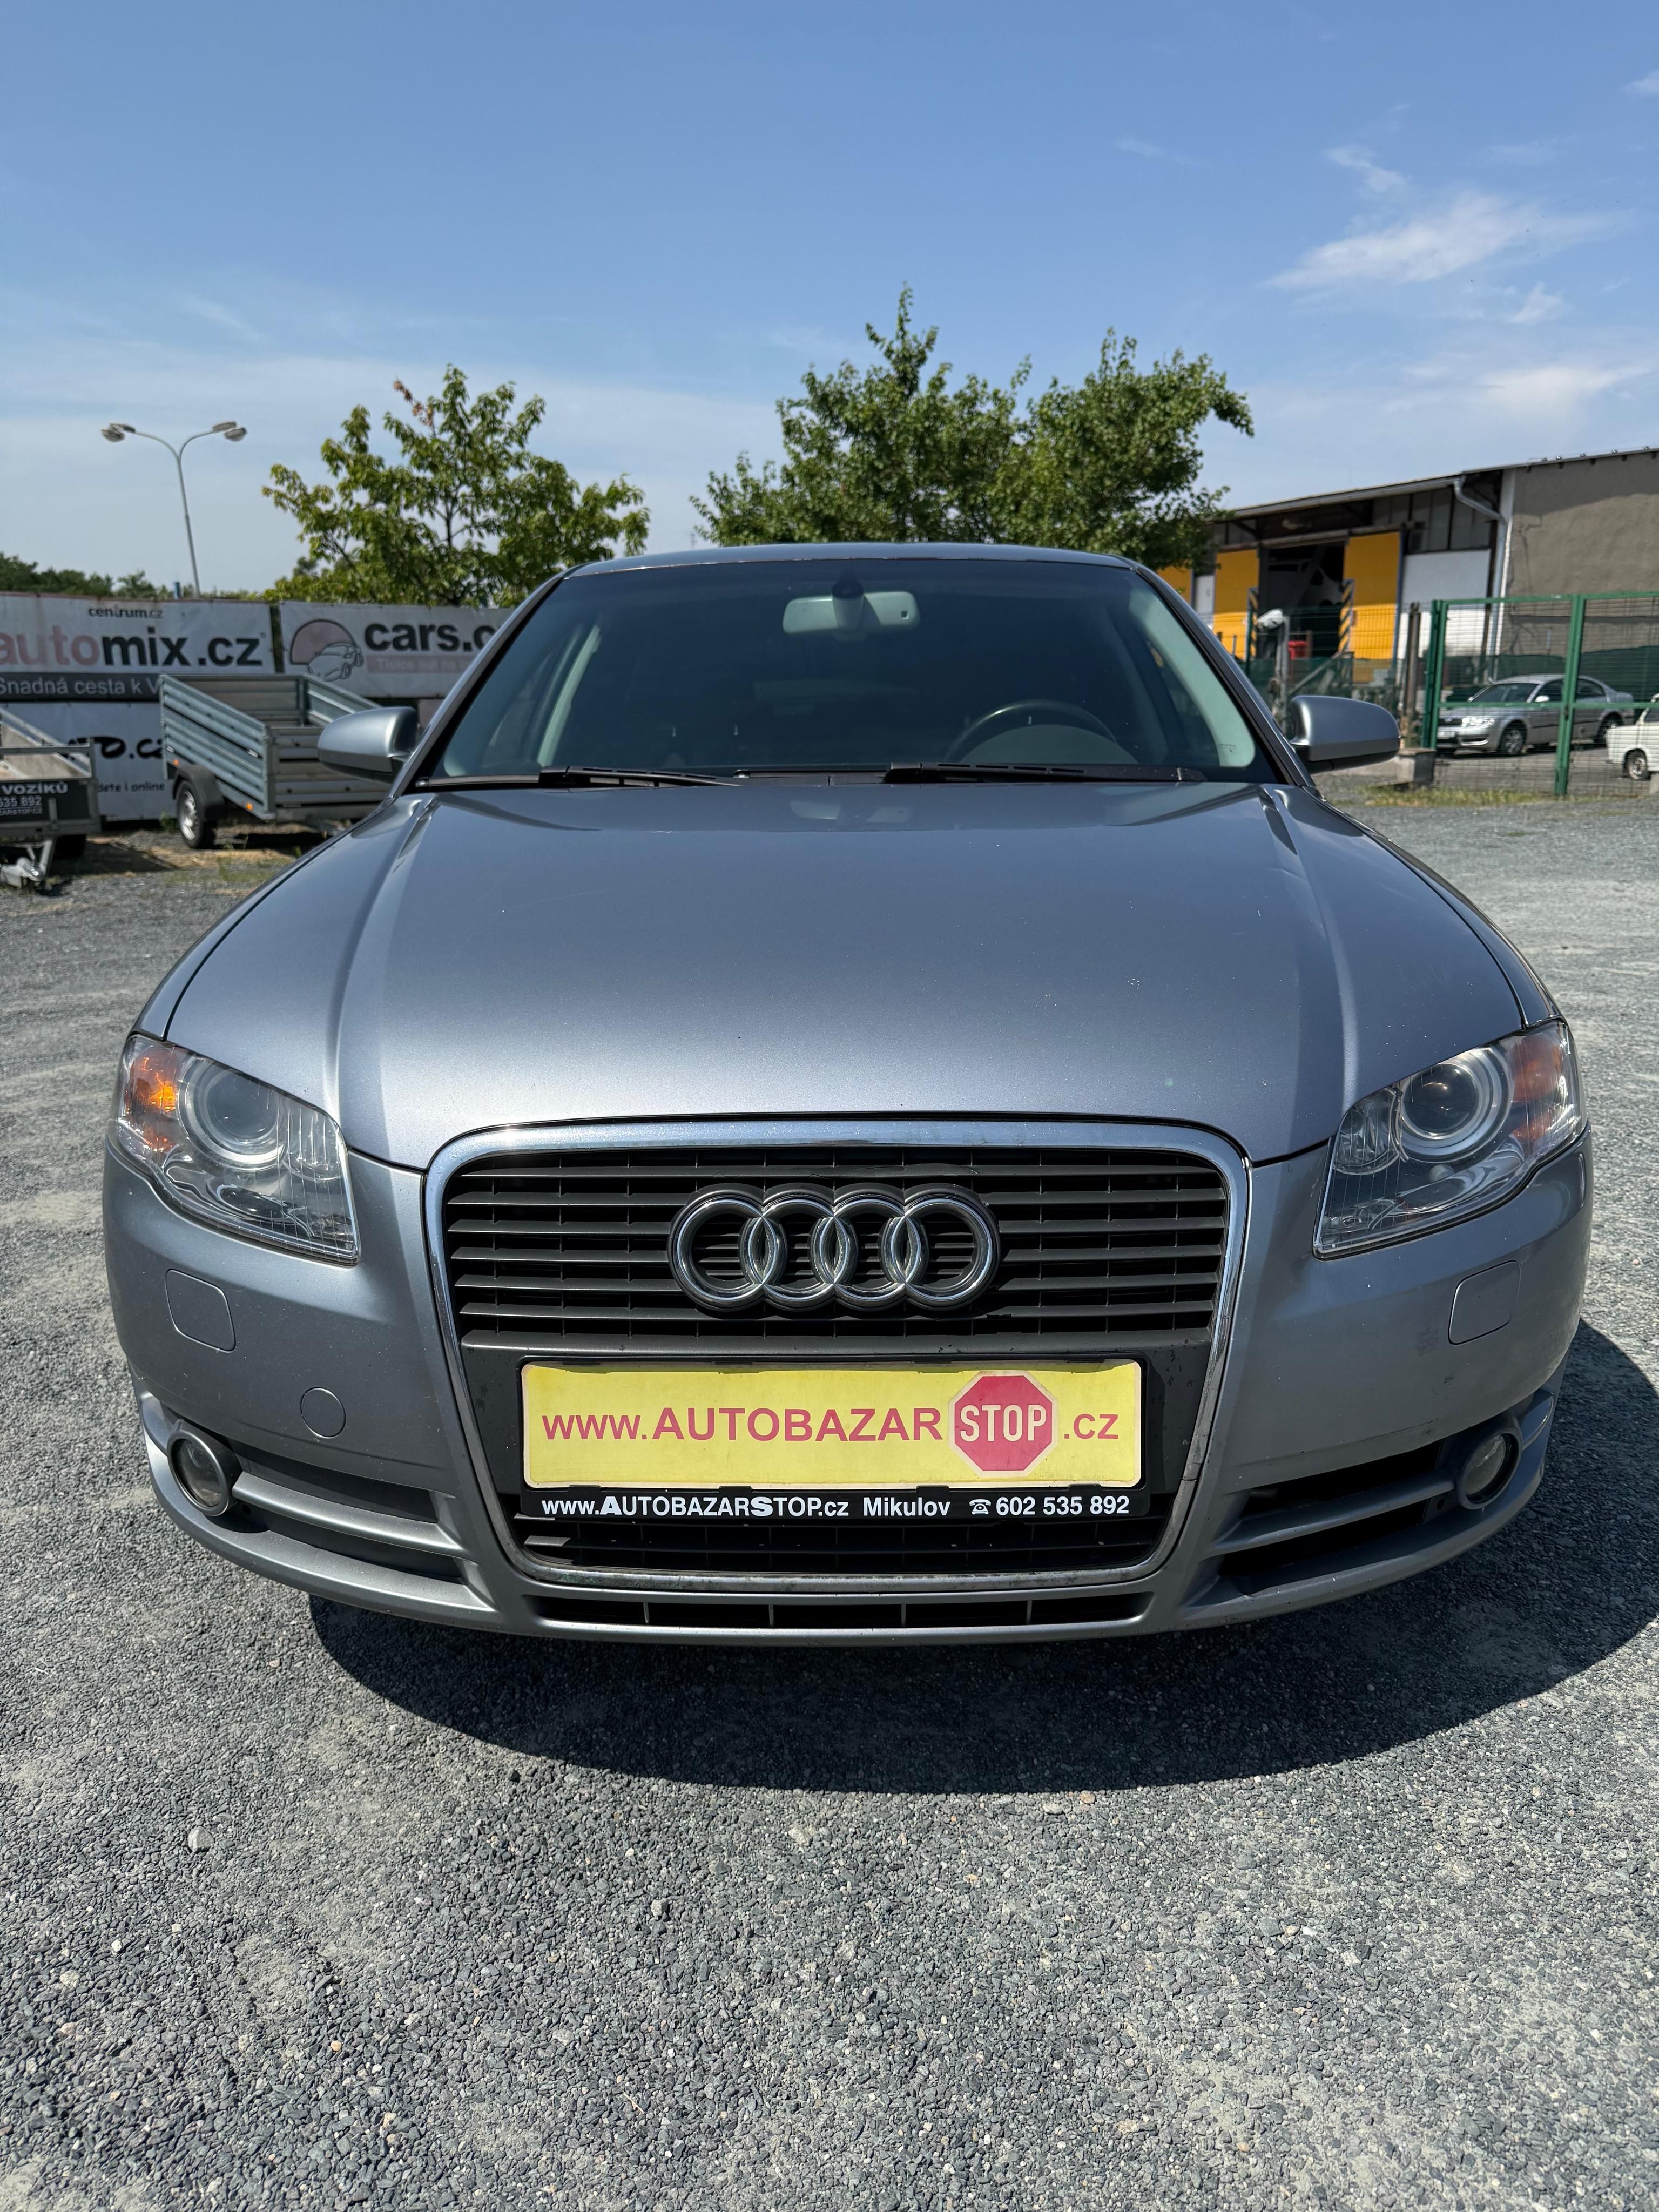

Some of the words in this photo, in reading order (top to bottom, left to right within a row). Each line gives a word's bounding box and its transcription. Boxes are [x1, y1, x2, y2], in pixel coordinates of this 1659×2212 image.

[89, 605, 164, 618] centrum.cz
[0, 625, 263, 667] automix.cz
[73, 678, 125, 695] cesta
[131, 677, 143, 694] k
[131, 781, 165, 792] online
[959, 1404, 1048, 1442] STOP
[541, 1495, 849, 1517] www.AUTOBAZARSTOP.cz
[863, 1496, 951, 1517] Mikulov
[995, 1496, 1036, 1516] 602
[1042, 1495, 1083, 1516] 535
[1089, 1495, 1130, 1515] 892
